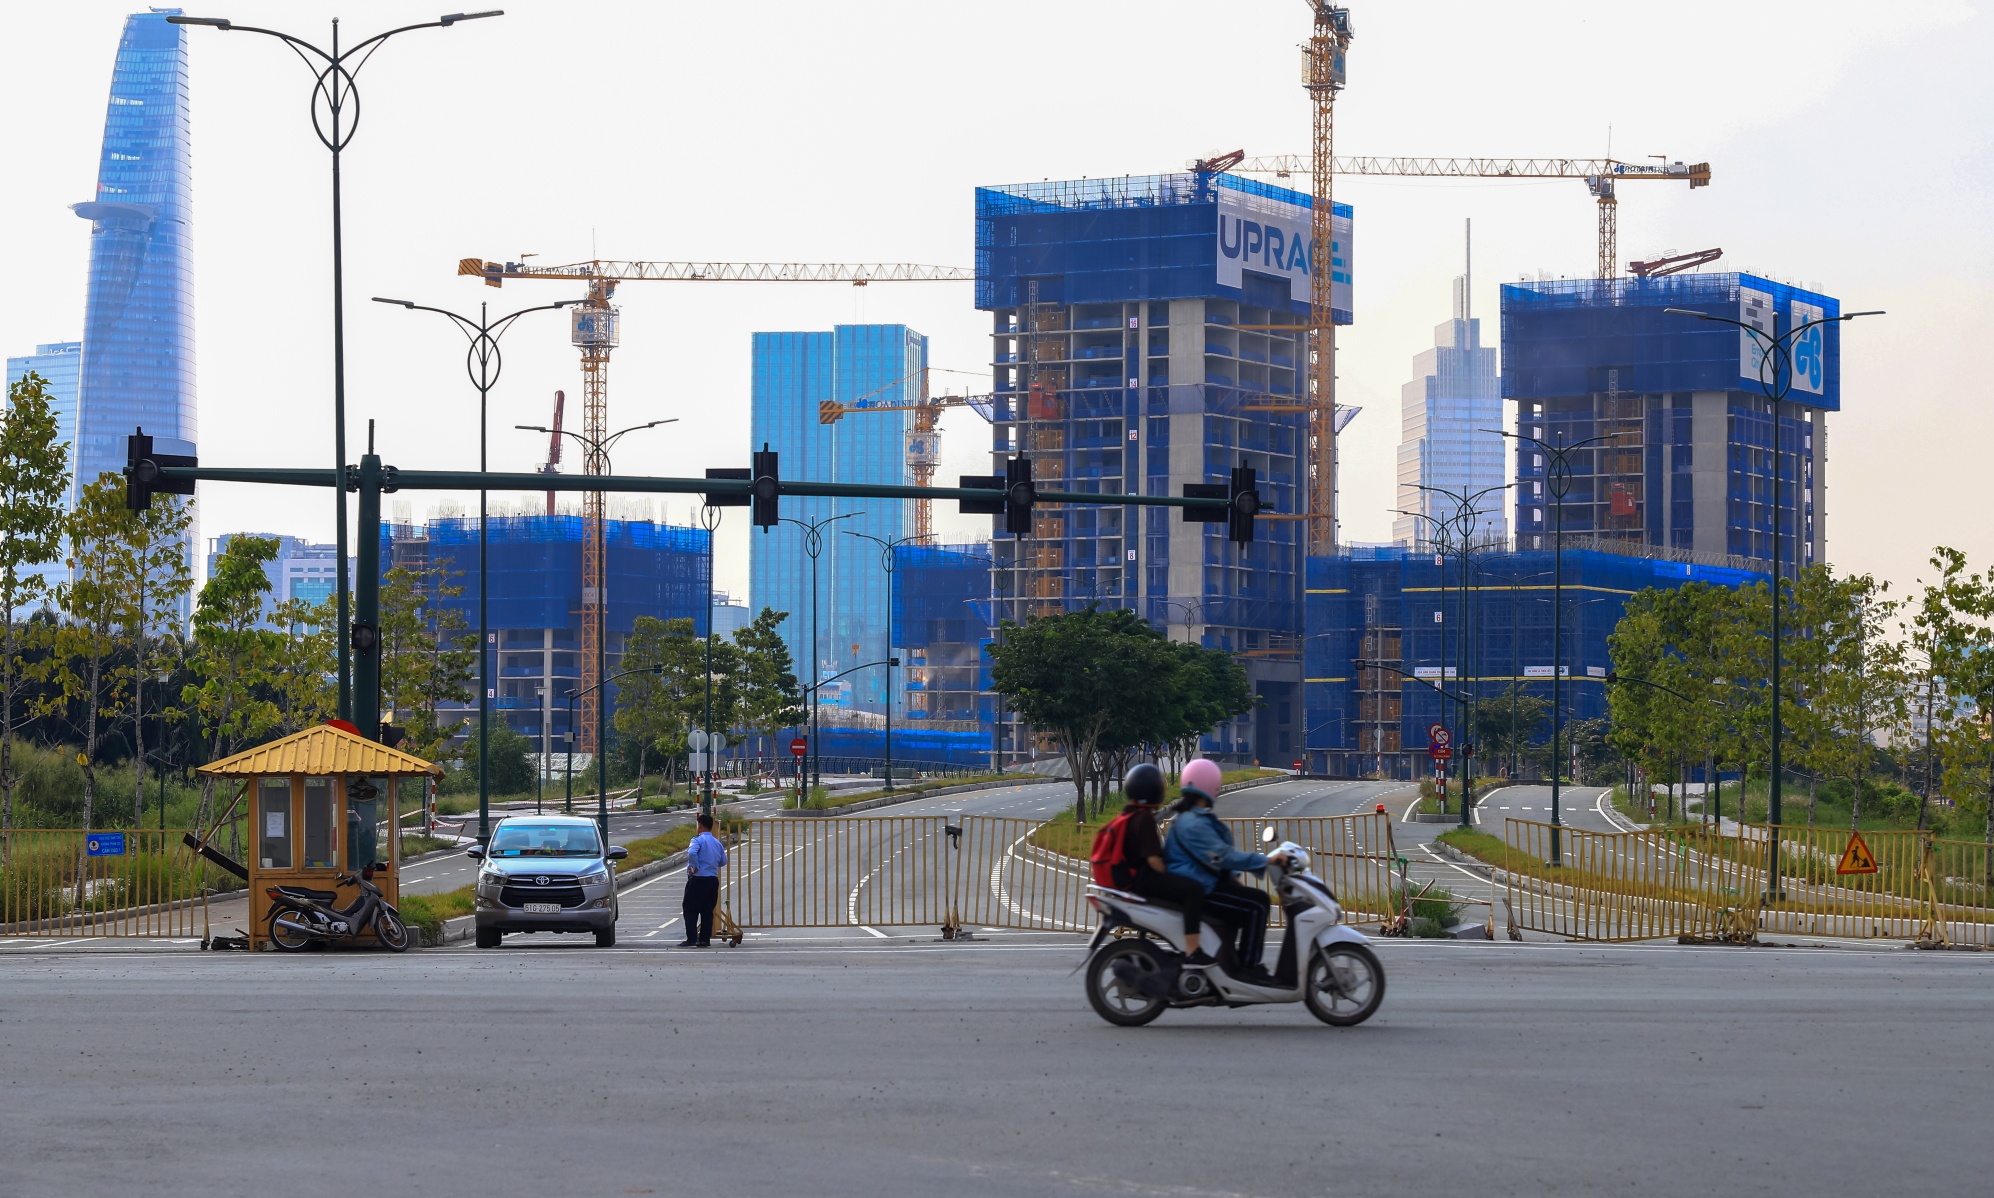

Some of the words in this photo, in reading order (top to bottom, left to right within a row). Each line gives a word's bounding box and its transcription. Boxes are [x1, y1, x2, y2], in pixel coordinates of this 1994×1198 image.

[1129, 432, 1137, 440] 12
[1436, 556, 1442, 565] 8
[1436, 614, 1442, 622] 6
